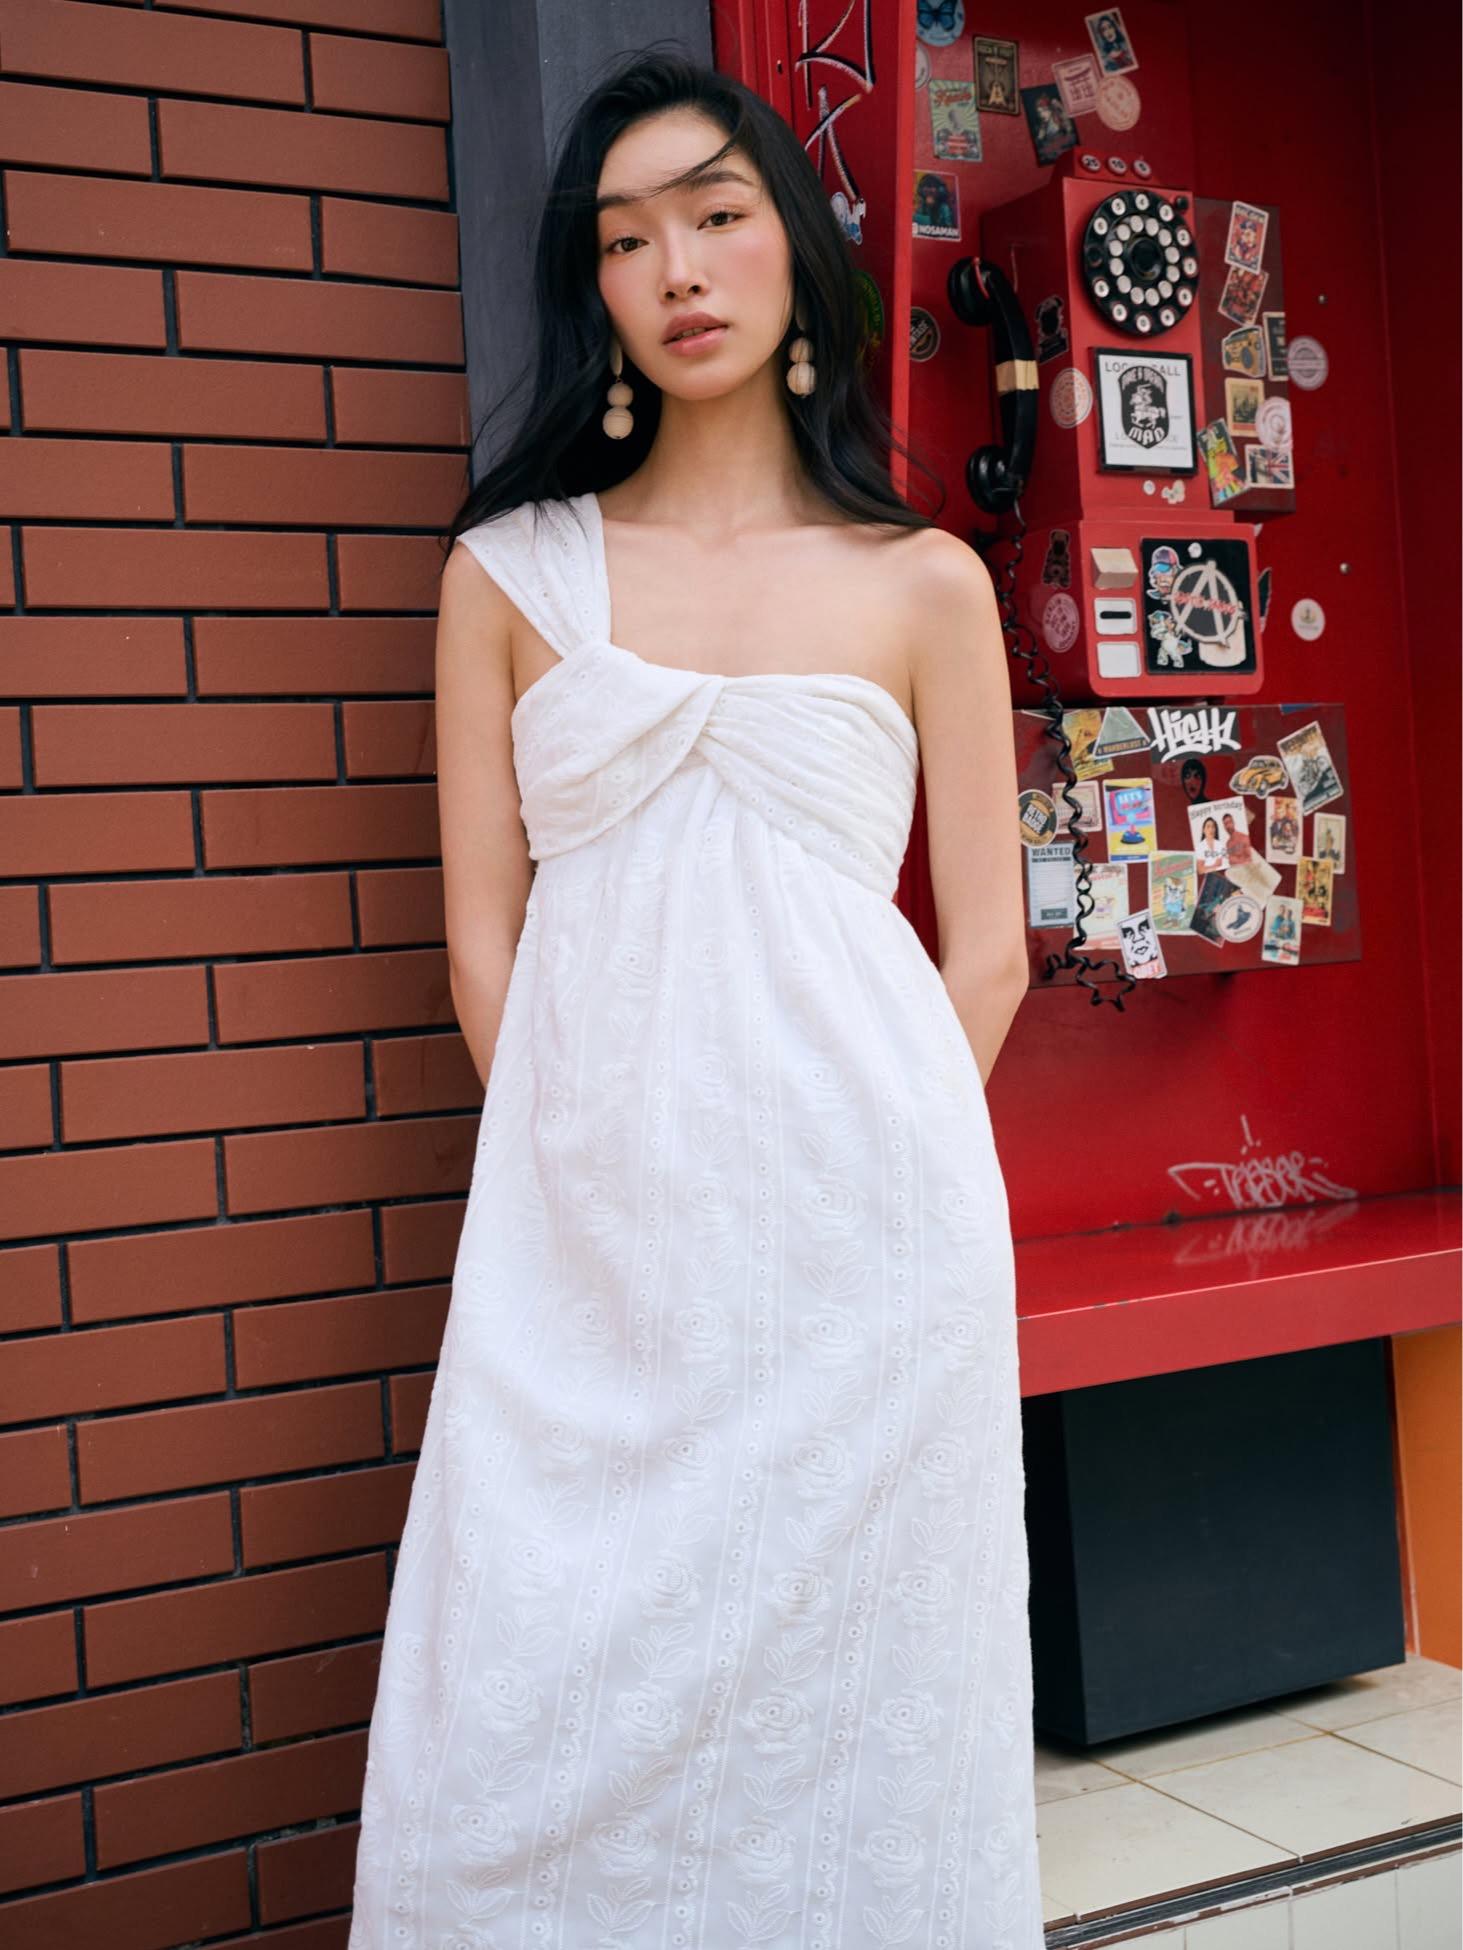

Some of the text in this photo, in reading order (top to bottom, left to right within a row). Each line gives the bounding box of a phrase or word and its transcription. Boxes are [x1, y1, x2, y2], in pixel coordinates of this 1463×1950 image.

[1152, 363, 1181, 377] ALL
[1213, 801, 1243, 812] birthday
[1032, 847, 1071, 856] WANTED
